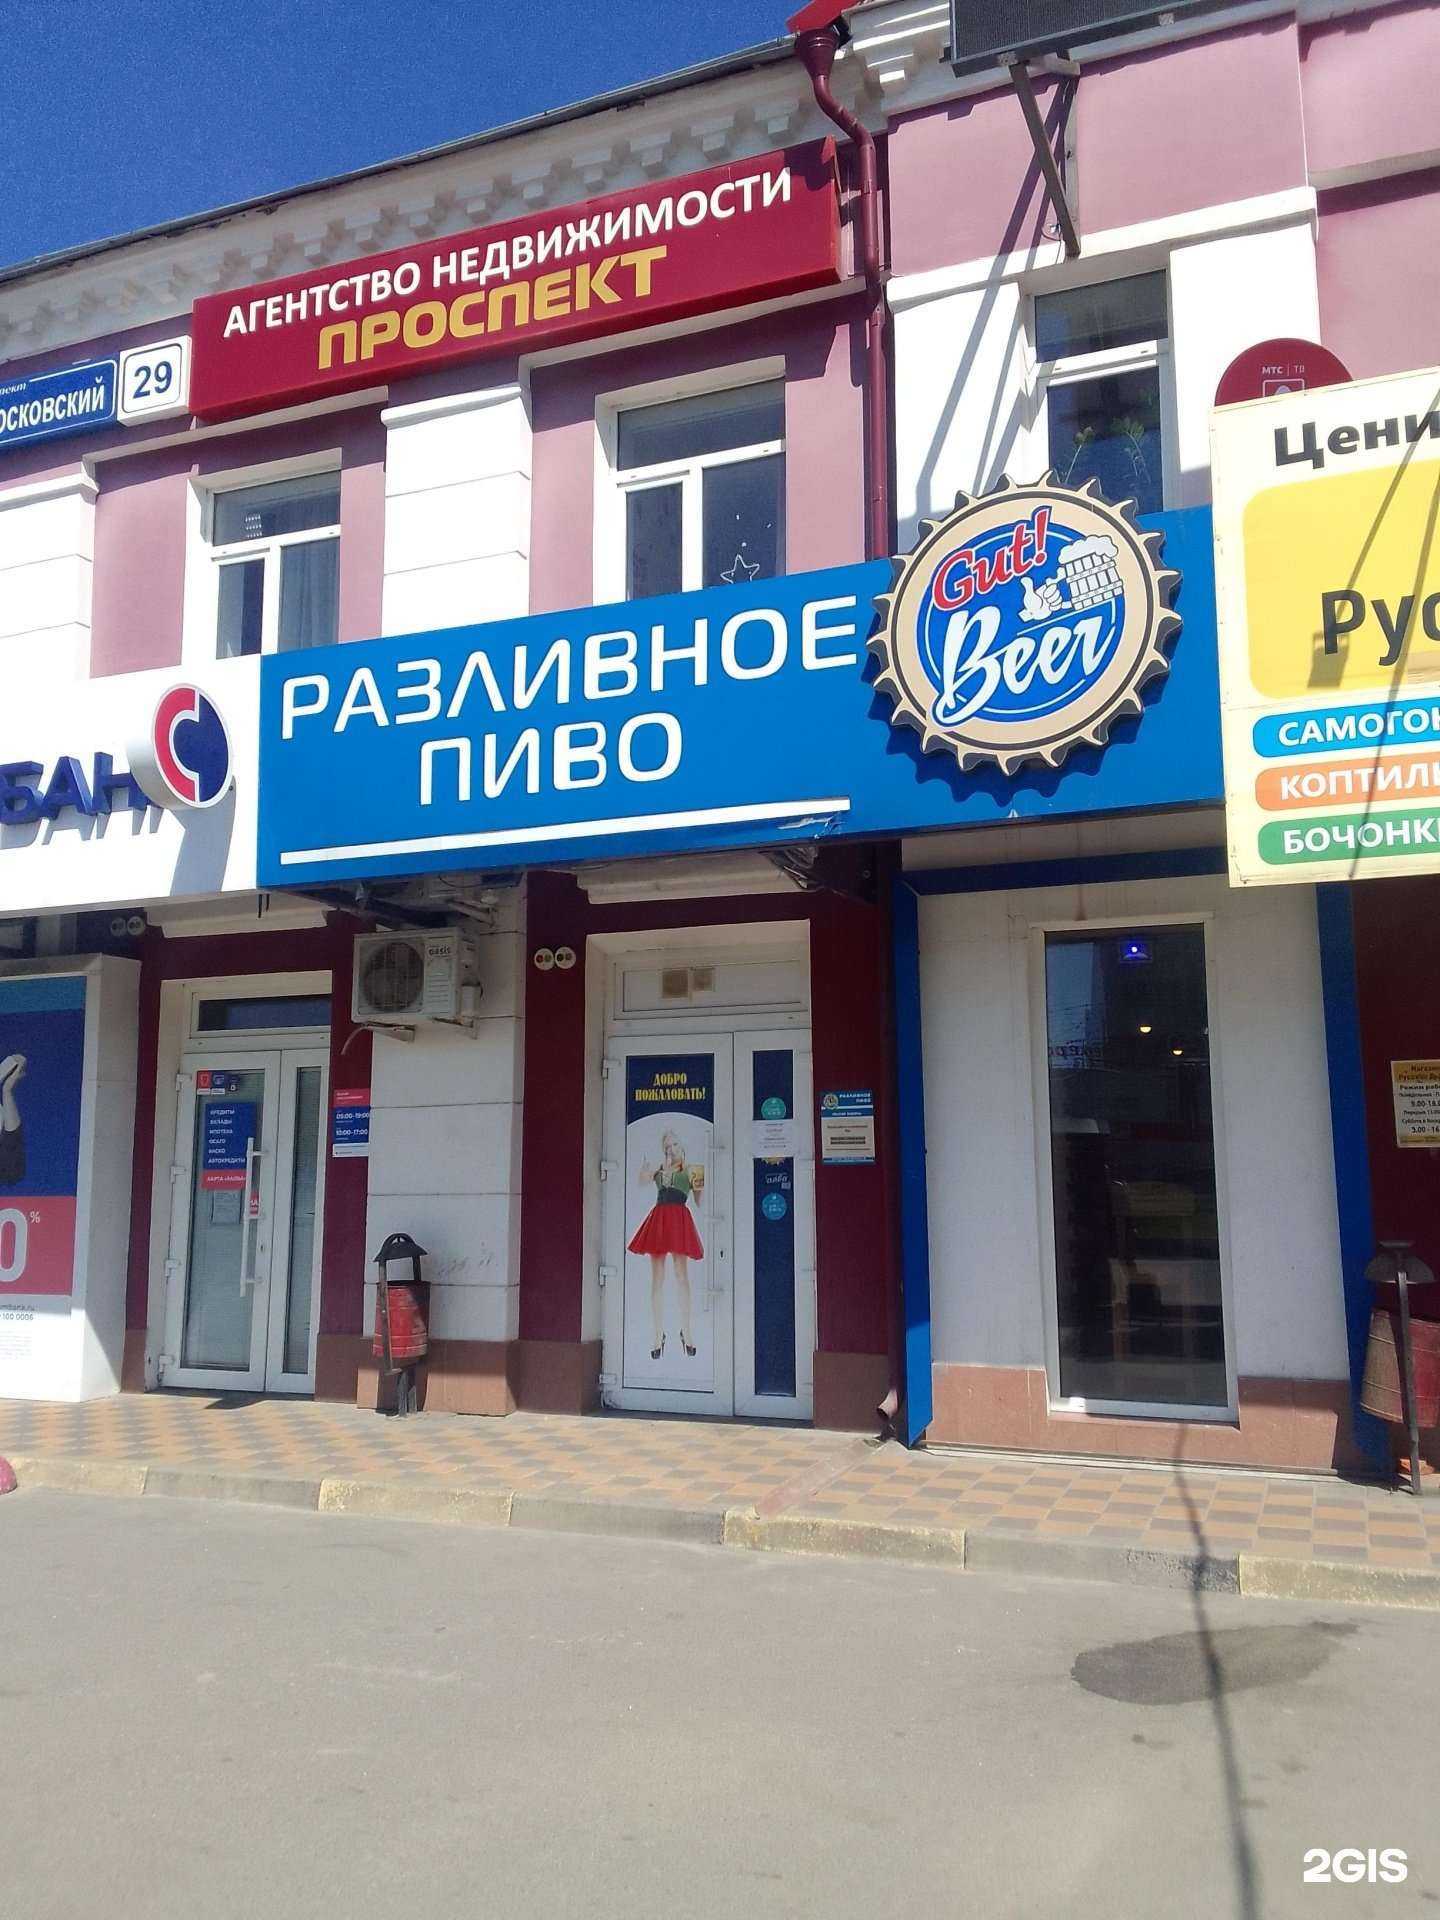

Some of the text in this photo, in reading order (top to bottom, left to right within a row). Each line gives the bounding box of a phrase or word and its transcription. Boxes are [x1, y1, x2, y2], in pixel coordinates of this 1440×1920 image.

[223, 166, 792, 338] АГЕНТСТВО НЕДВИЖИМОСТИ
[318, 246, 668, 370] ПРОСПЕКТ
[133, 360, 173, 399] 29
[1262, 366, 1283, 375] МТС
[1274, 410, 1440, 470] Цени
[932, 507, 1051, 610] Gut!
[281, 594, 857, 740] РАЗЛИВНОЕ
[936, 604, 1116, 724] Beer
[0, 751, 159, 825] БАН
[420, 711, 683, 806] ПИВО
[1282, 817, 1440, 855] БОЧОНК
[634, 1086, 706, 1102] ПОЖАЛОВАТЬ!
[653, 1072, 688, 1087] ДОБРО
